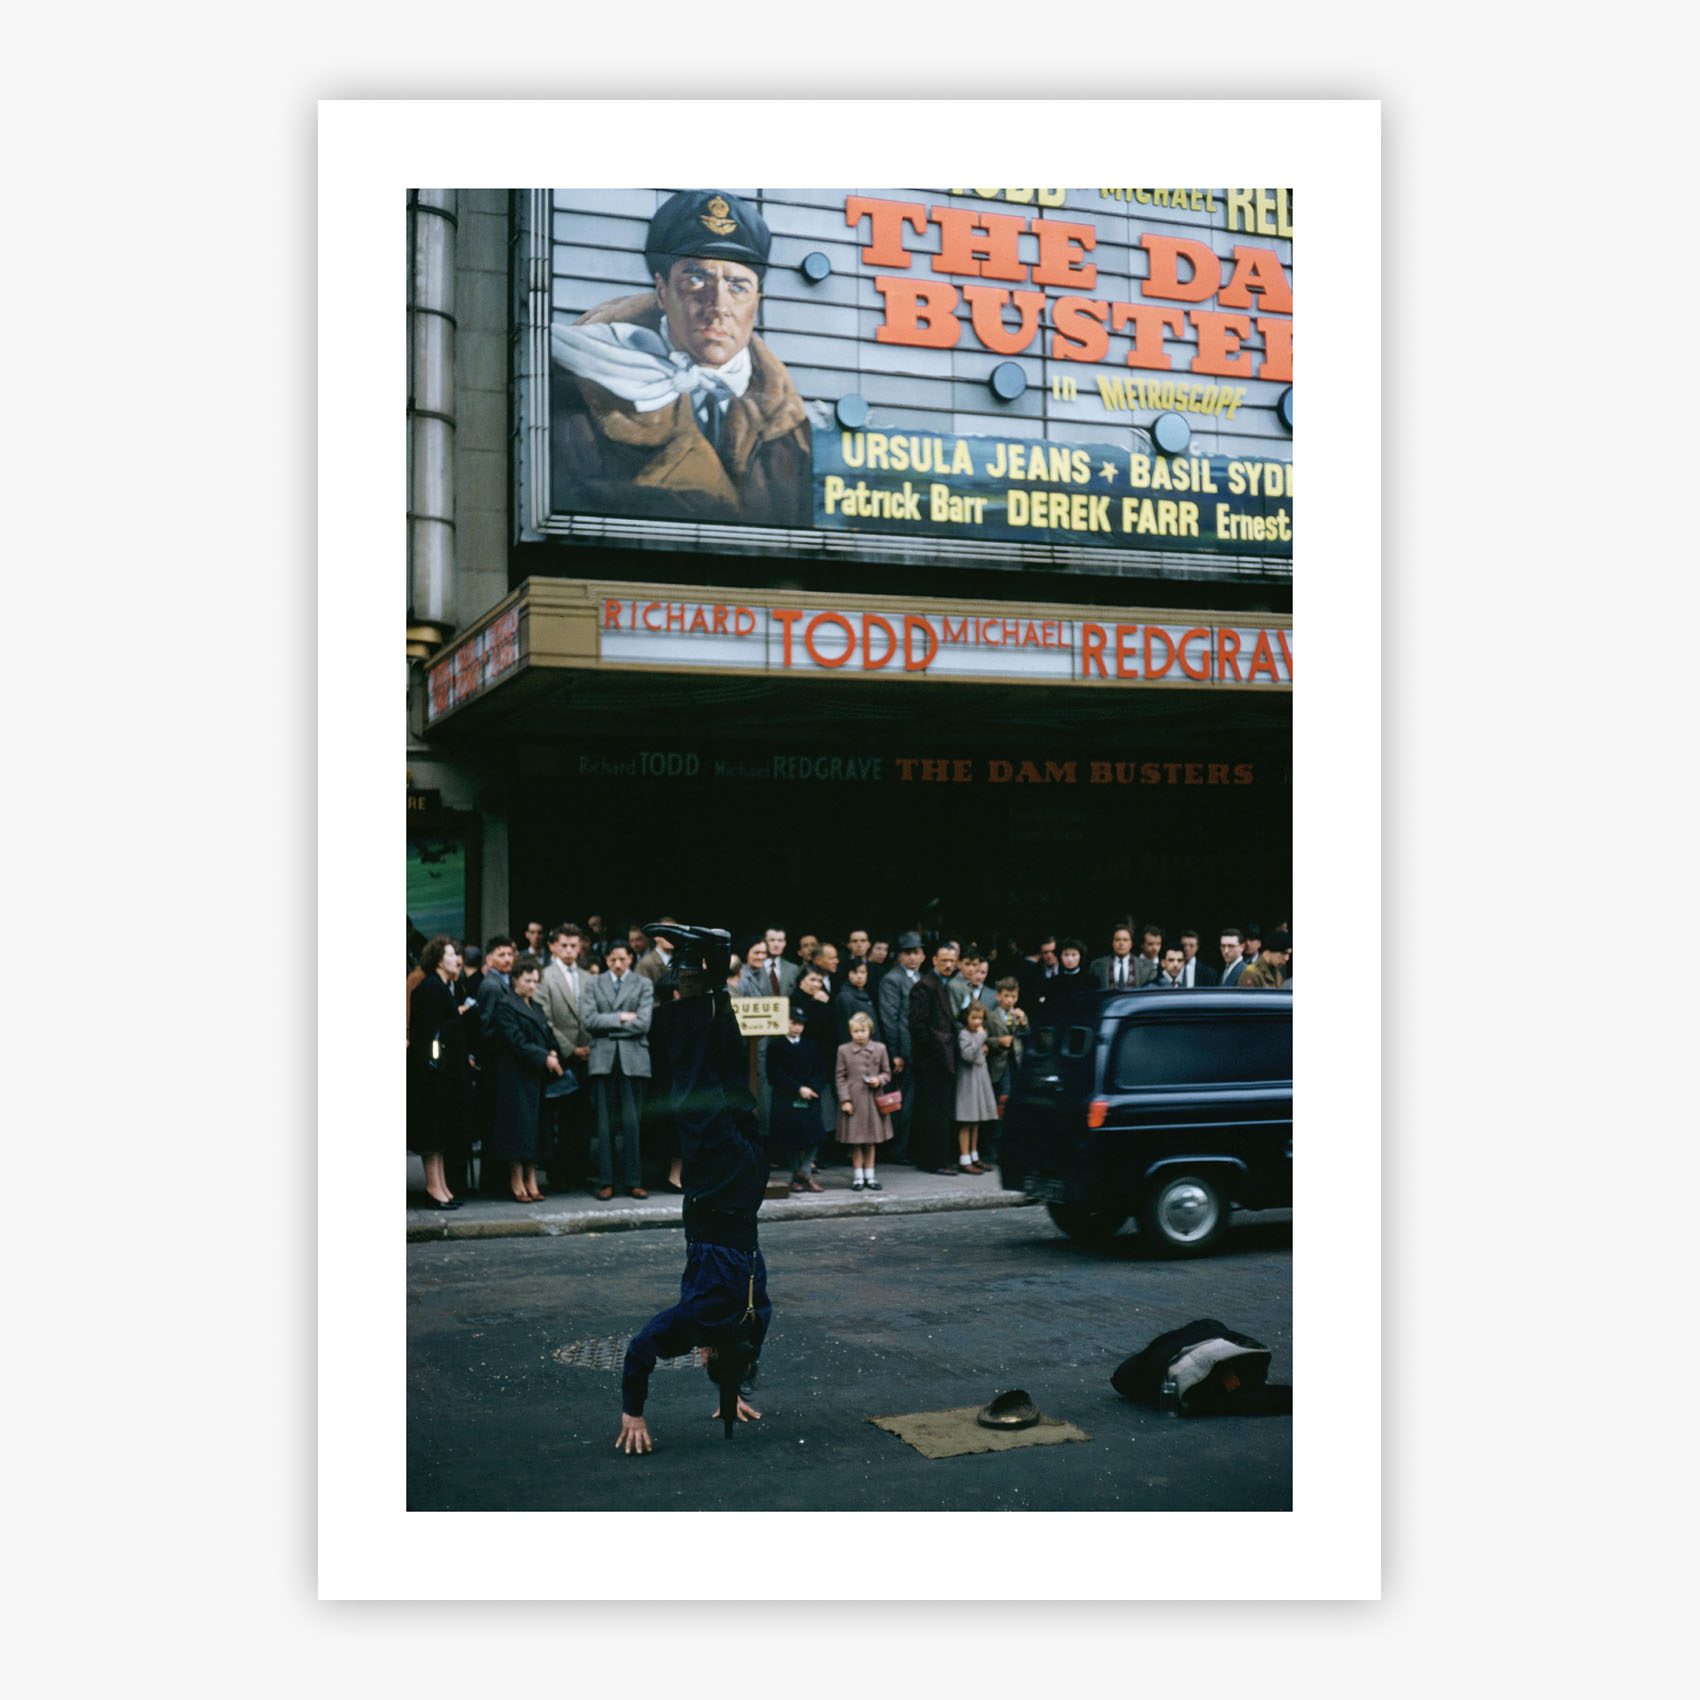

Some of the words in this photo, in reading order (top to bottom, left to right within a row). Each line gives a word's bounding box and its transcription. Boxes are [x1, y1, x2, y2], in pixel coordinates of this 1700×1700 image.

[846, 195, 1098, 290] THE
[1096, 374, 1247, 421] METROSCOPE
[841, 431, 974, 476] URSULA
[986, 443, 1091, 484] JEANS
[1130, 452, 1218, 494] BASIL
[824, 475, 922, 521] Patrick
[930, 483, 988, 524] Barr
[1007, 489, 1112, 533] DEREK
[1122, 497, 1199, 537] FARR
[1216, 502, 1291, 542] Ernest
[603, 599, 756, 637] RICHARD
[772, 609, 939, 672] TODD
[942, 616, 1071, 648] MICHAEL
[579, 755, 636, 776] Richard
[640, 752, 700, 777] TODD
[773, 755, 883, 781] REDGRAVE
[896, 758, 973, 784] THE
[988, 760, 1077, 784] DAM
[1090, 761, 1254, 785] BUSTERS
